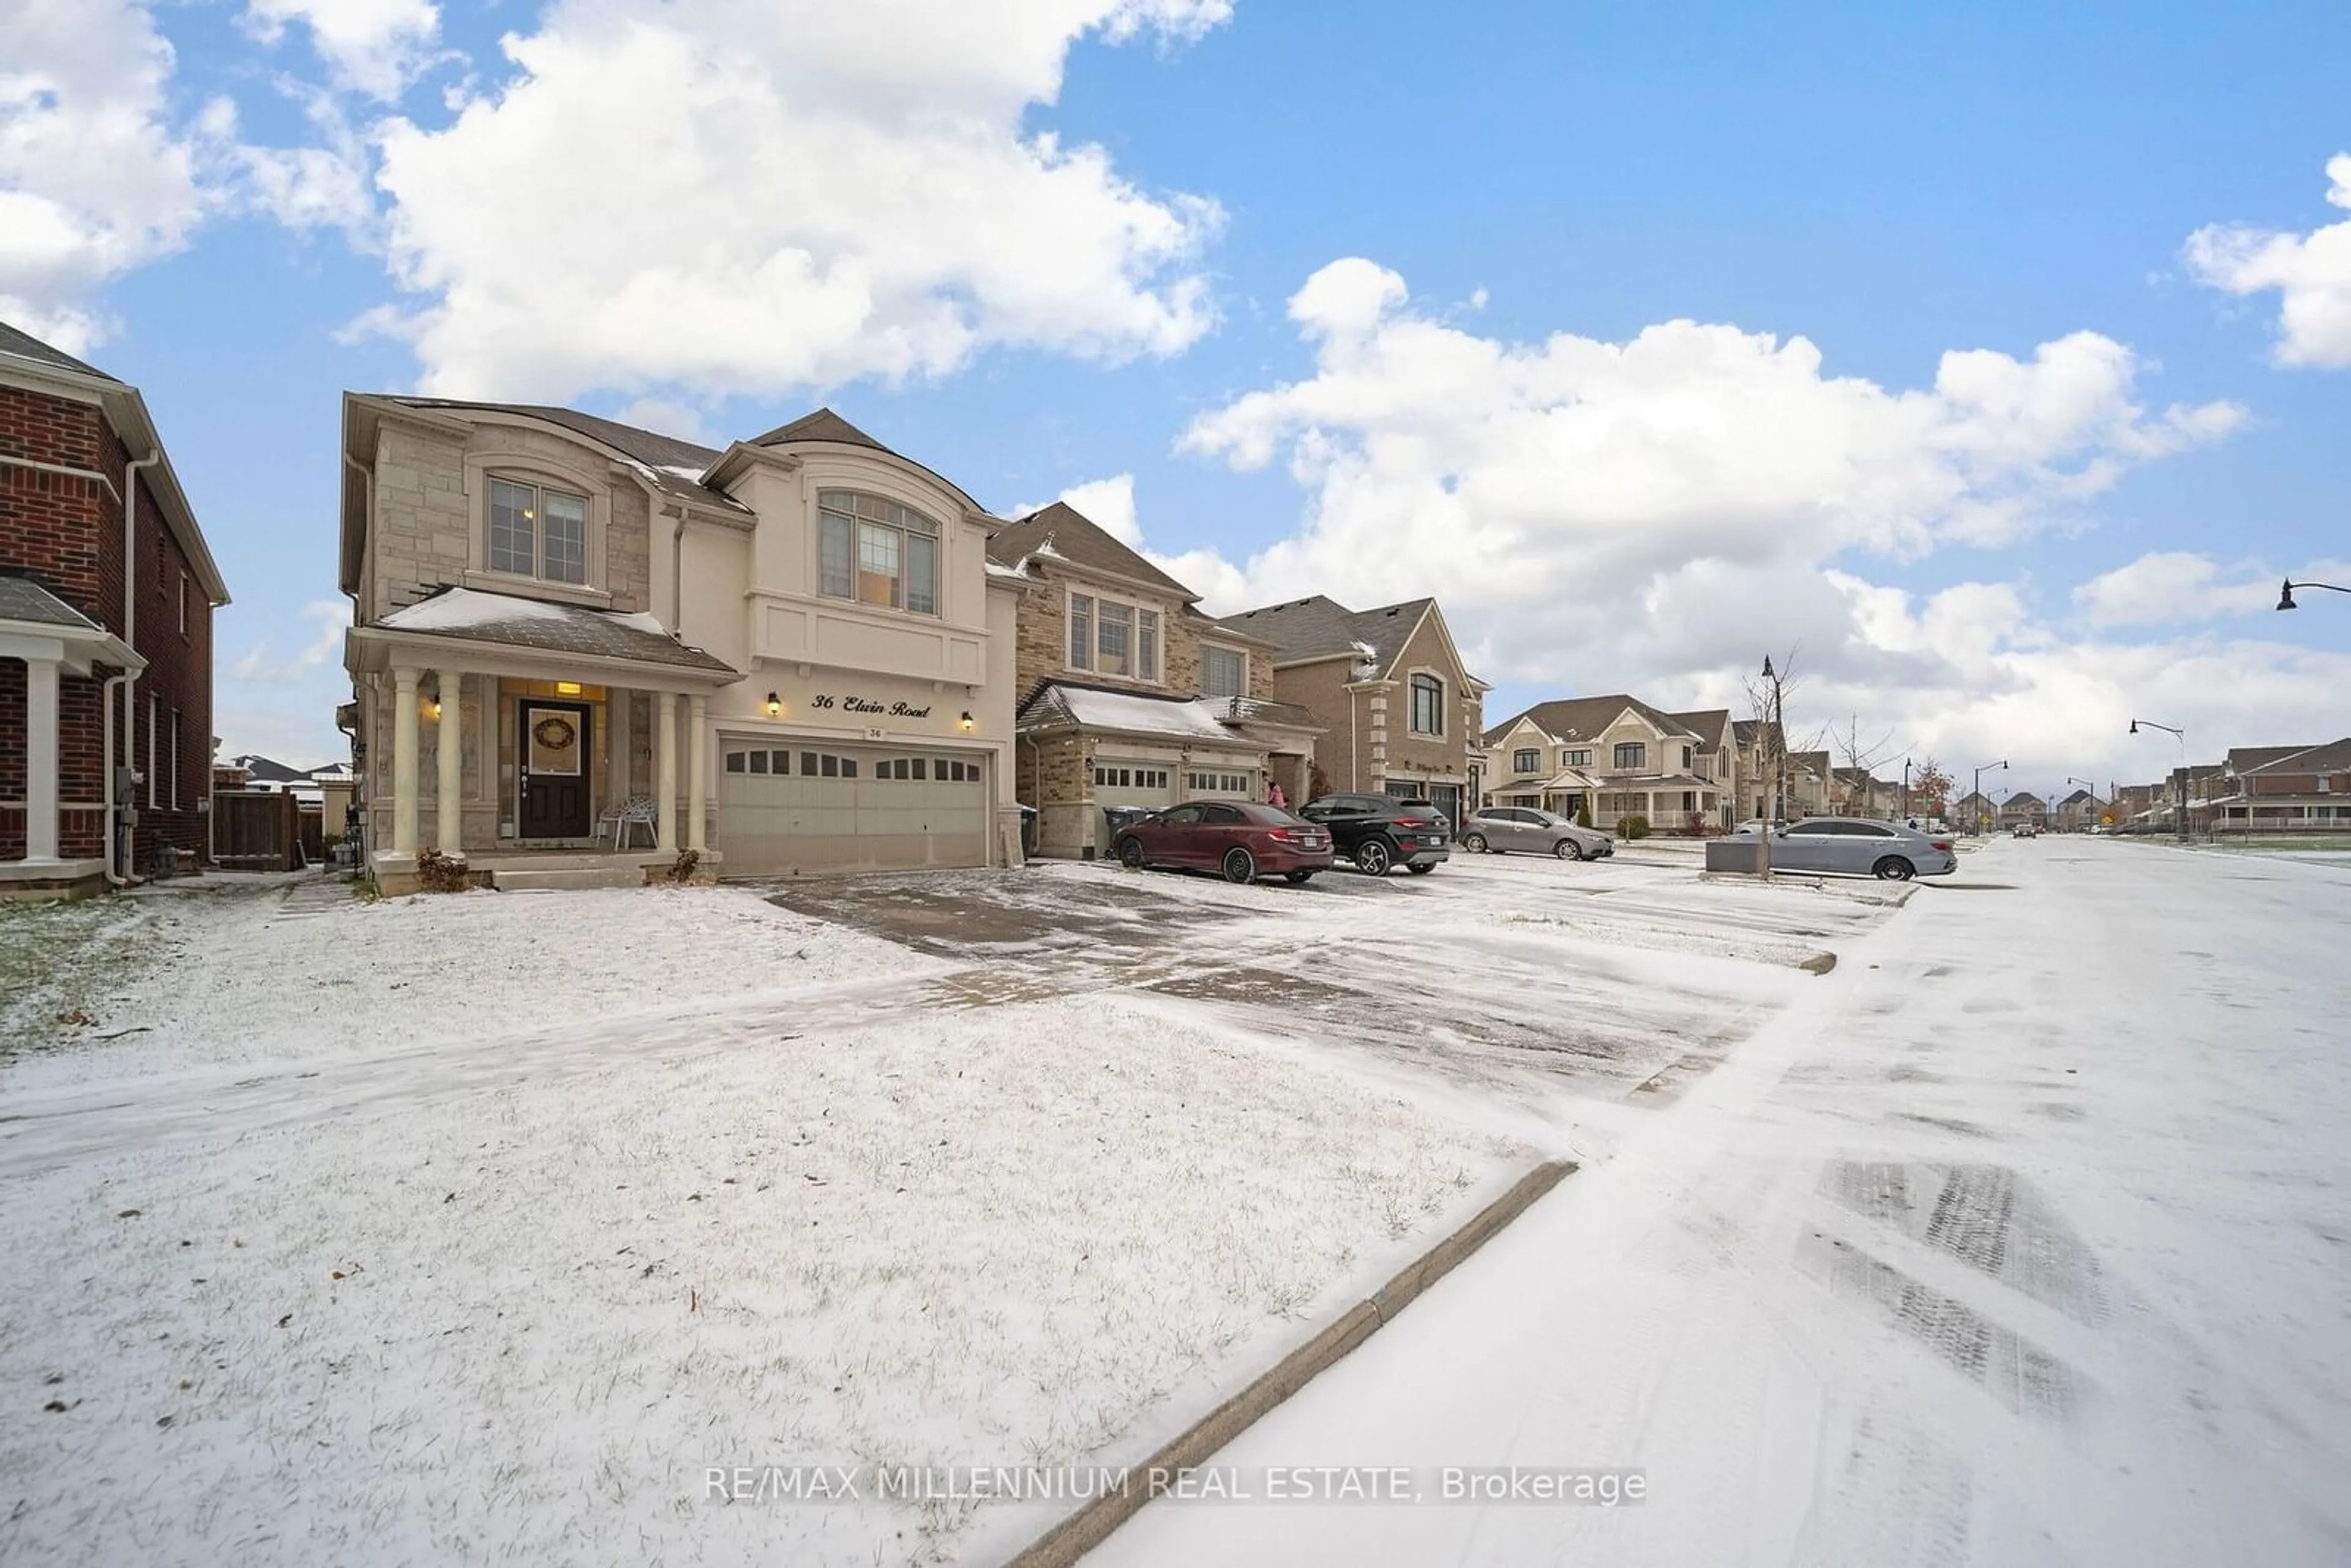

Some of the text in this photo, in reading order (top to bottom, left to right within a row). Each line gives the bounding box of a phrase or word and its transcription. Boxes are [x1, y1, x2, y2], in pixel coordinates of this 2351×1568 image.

[811, 694, 834, 708] 36
[888, 702, 931, 718] Road
[869, 729, 881, 737] 36
